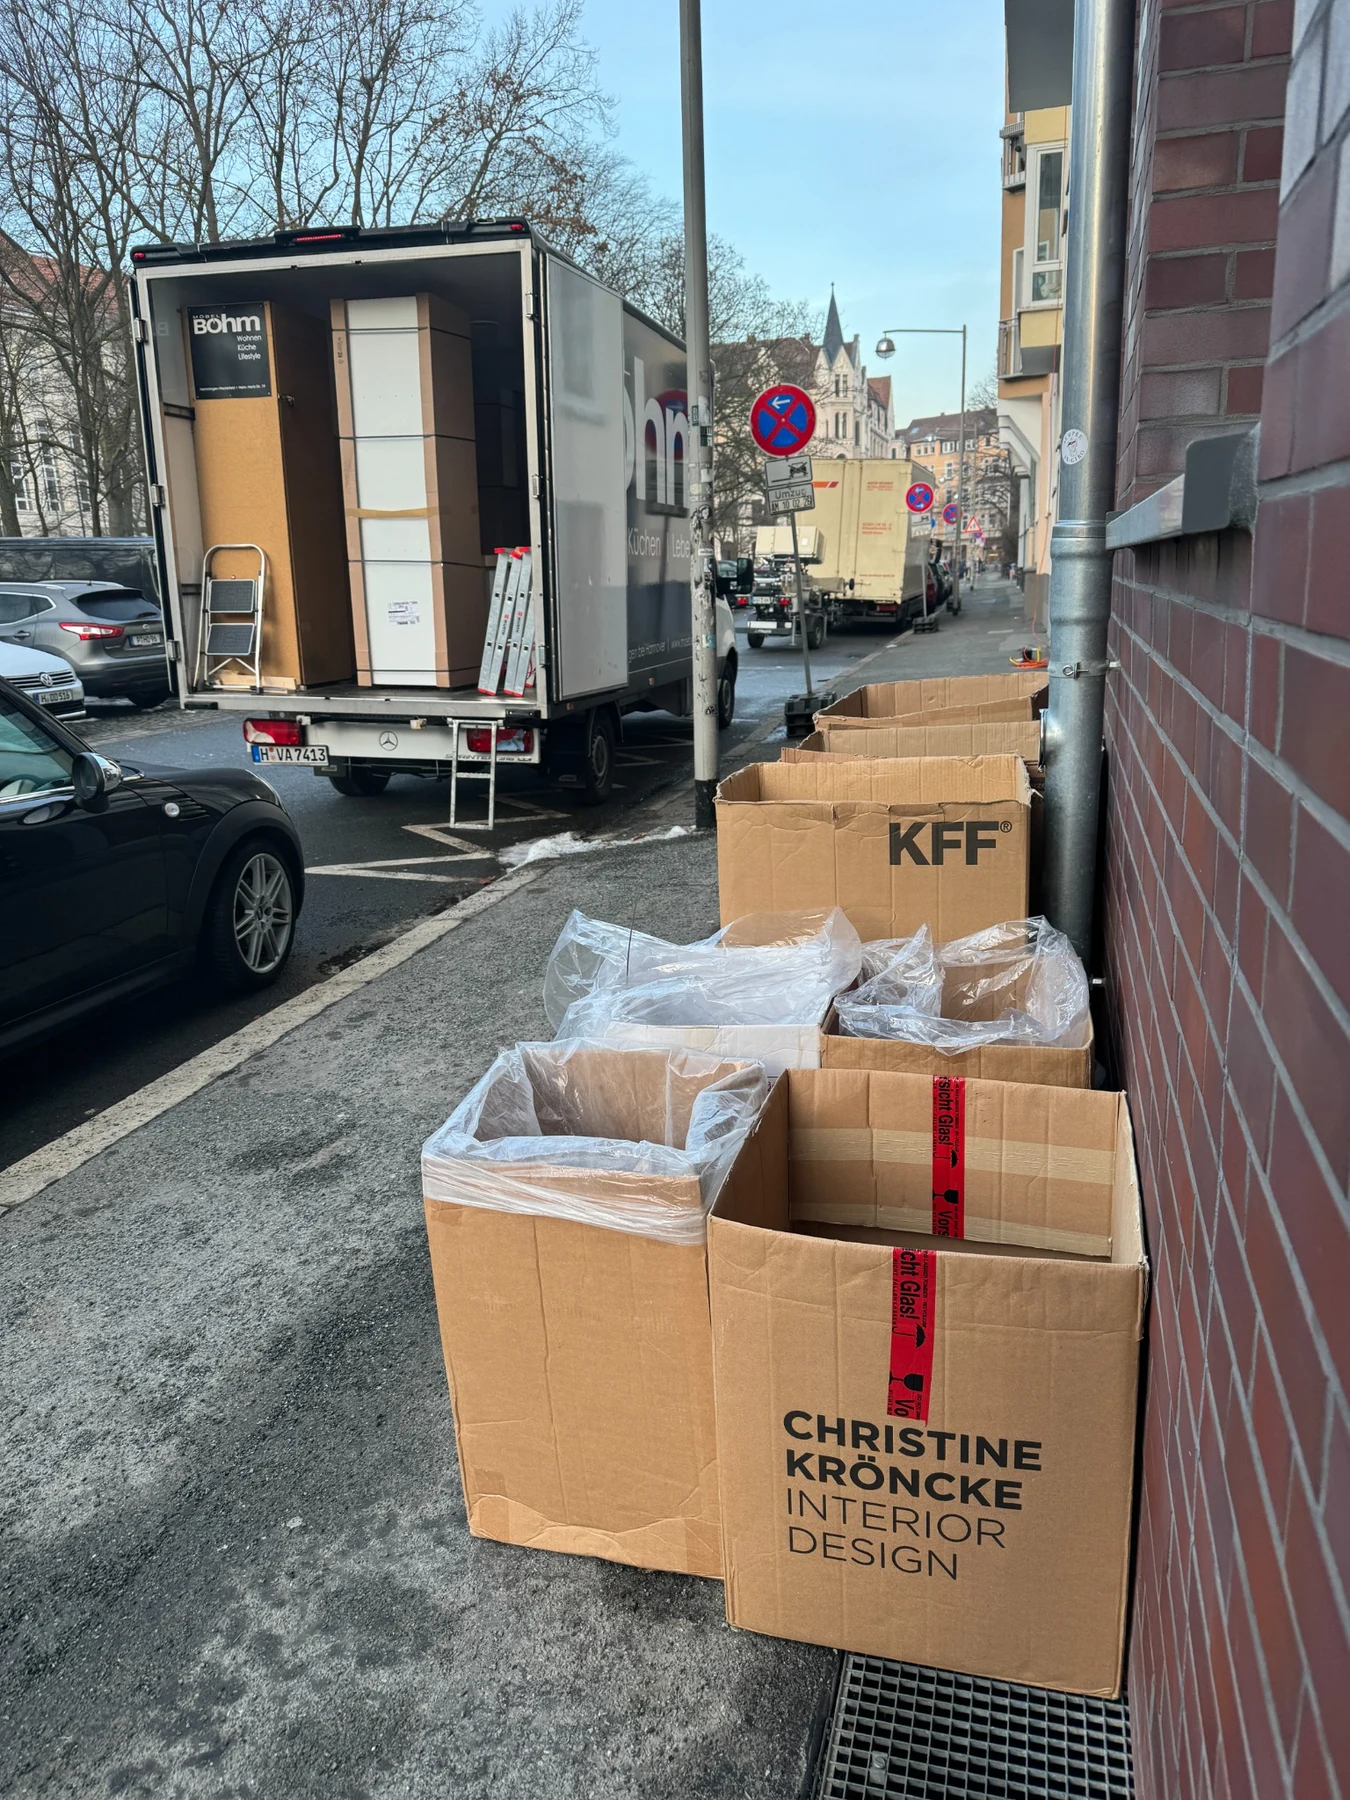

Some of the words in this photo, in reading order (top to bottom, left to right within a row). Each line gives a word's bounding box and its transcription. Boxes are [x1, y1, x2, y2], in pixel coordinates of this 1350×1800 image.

[237, 334, 262, 342] Wohnen
[237, 343, 257, 351] Küche
[238, 352, 261, 361] Lifestyle
[775, 488, 806, 500] Umzug
[628, 528, 662, 556] Küchen
[260, 748, 270, 761] H
[294, 748, 326, 762] 7413
[938, 1114, 954, 1146] Glas!
[900, 1280, 921, 1320] Glas!
[783, 1410, 1043, 1472] CHRISTINE
[786, 1449, 1023, 1511] KRÖNCKE
[787, 1487, 1006, 1549] INTERIOR
[788, 1526, 958, 1581] DESIGN
